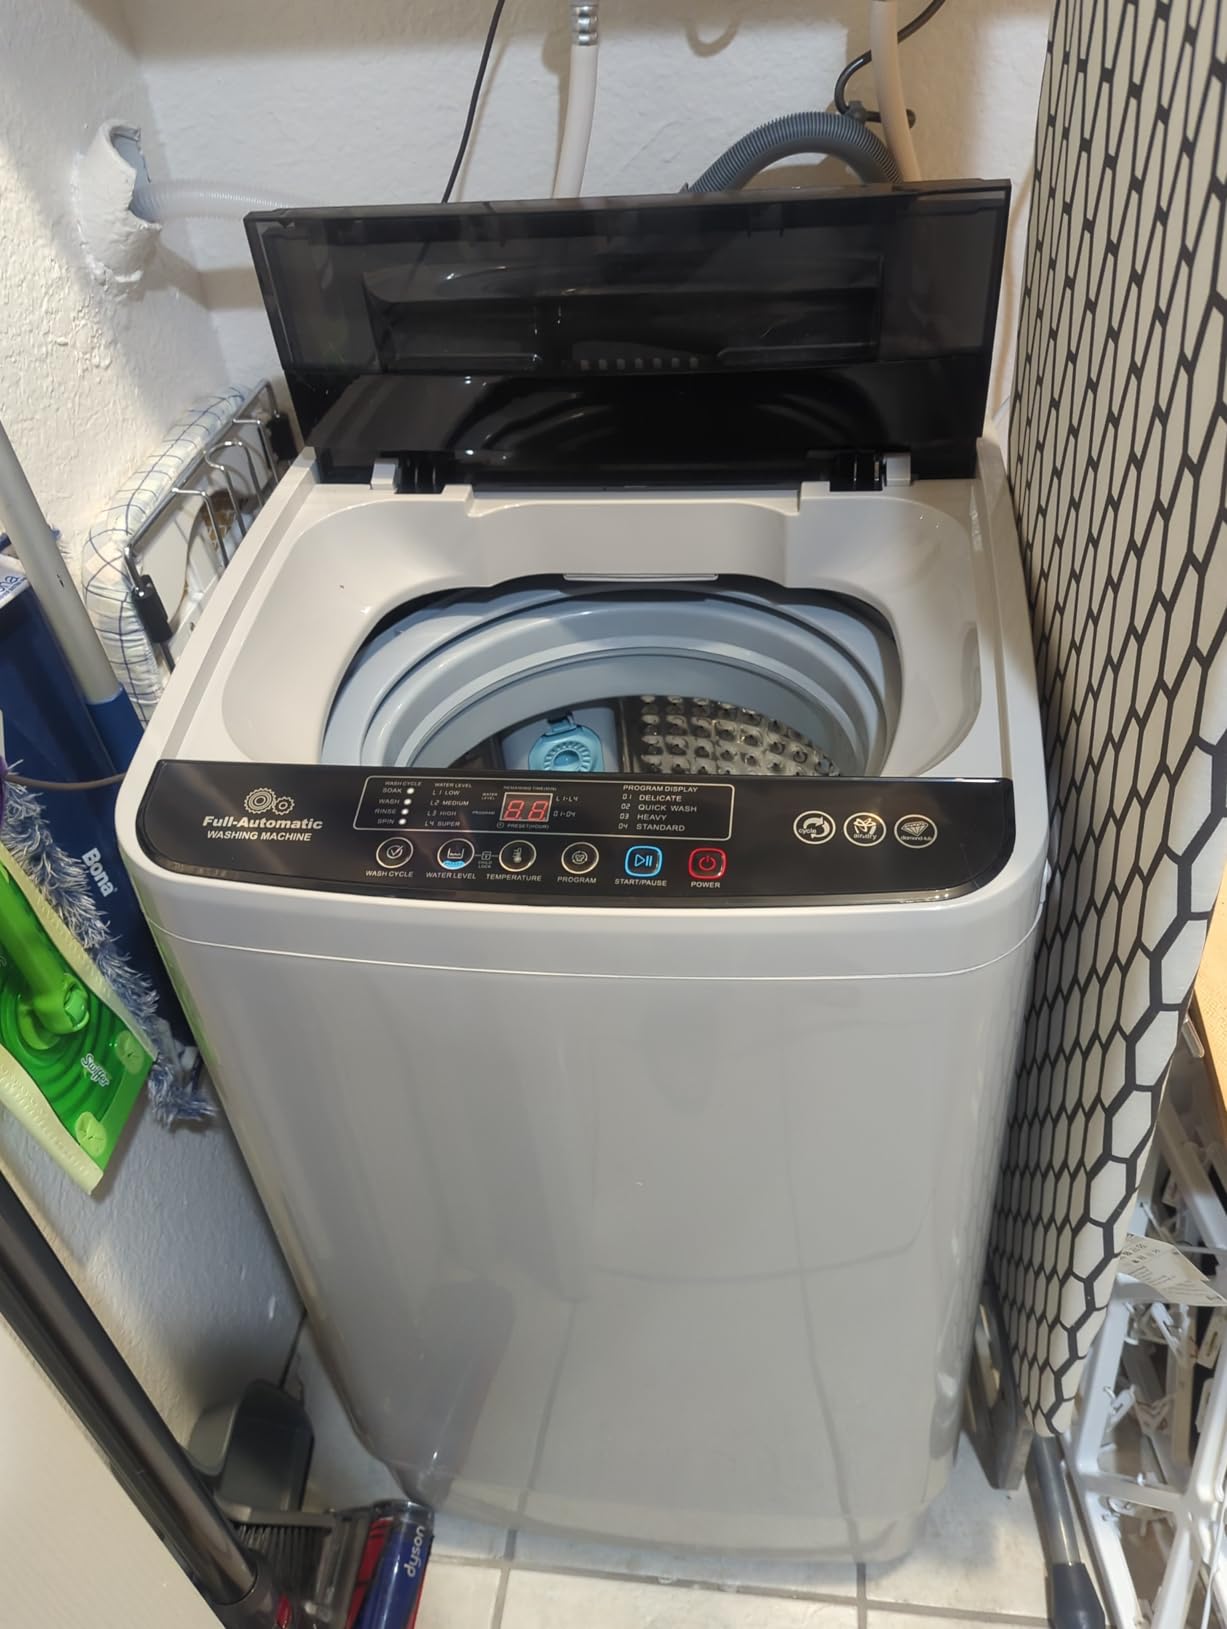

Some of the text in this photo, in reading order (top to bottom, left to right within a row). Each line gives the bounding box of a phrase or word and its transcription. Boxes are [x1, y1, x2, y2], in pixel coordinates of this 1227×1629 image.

[623, 784, 698, 793] PROGRAM DISPLAY
[639, 794, 682, 802] DELICATE
[202, 815, 323, 829] Full-Automatic
[207, 830, 312, 841] WASHING MACHINE
[81, 848, 114, 897] Bona
[486, 873, 542, 882] TEMPERATURE
[557, 876, 597, 884] PROGRAM
[614, 878, 667, 887] START/PAUSE
[80, 1052, 110, 1087] Swiffer
[404, 1526, 425, 1578] dyson
